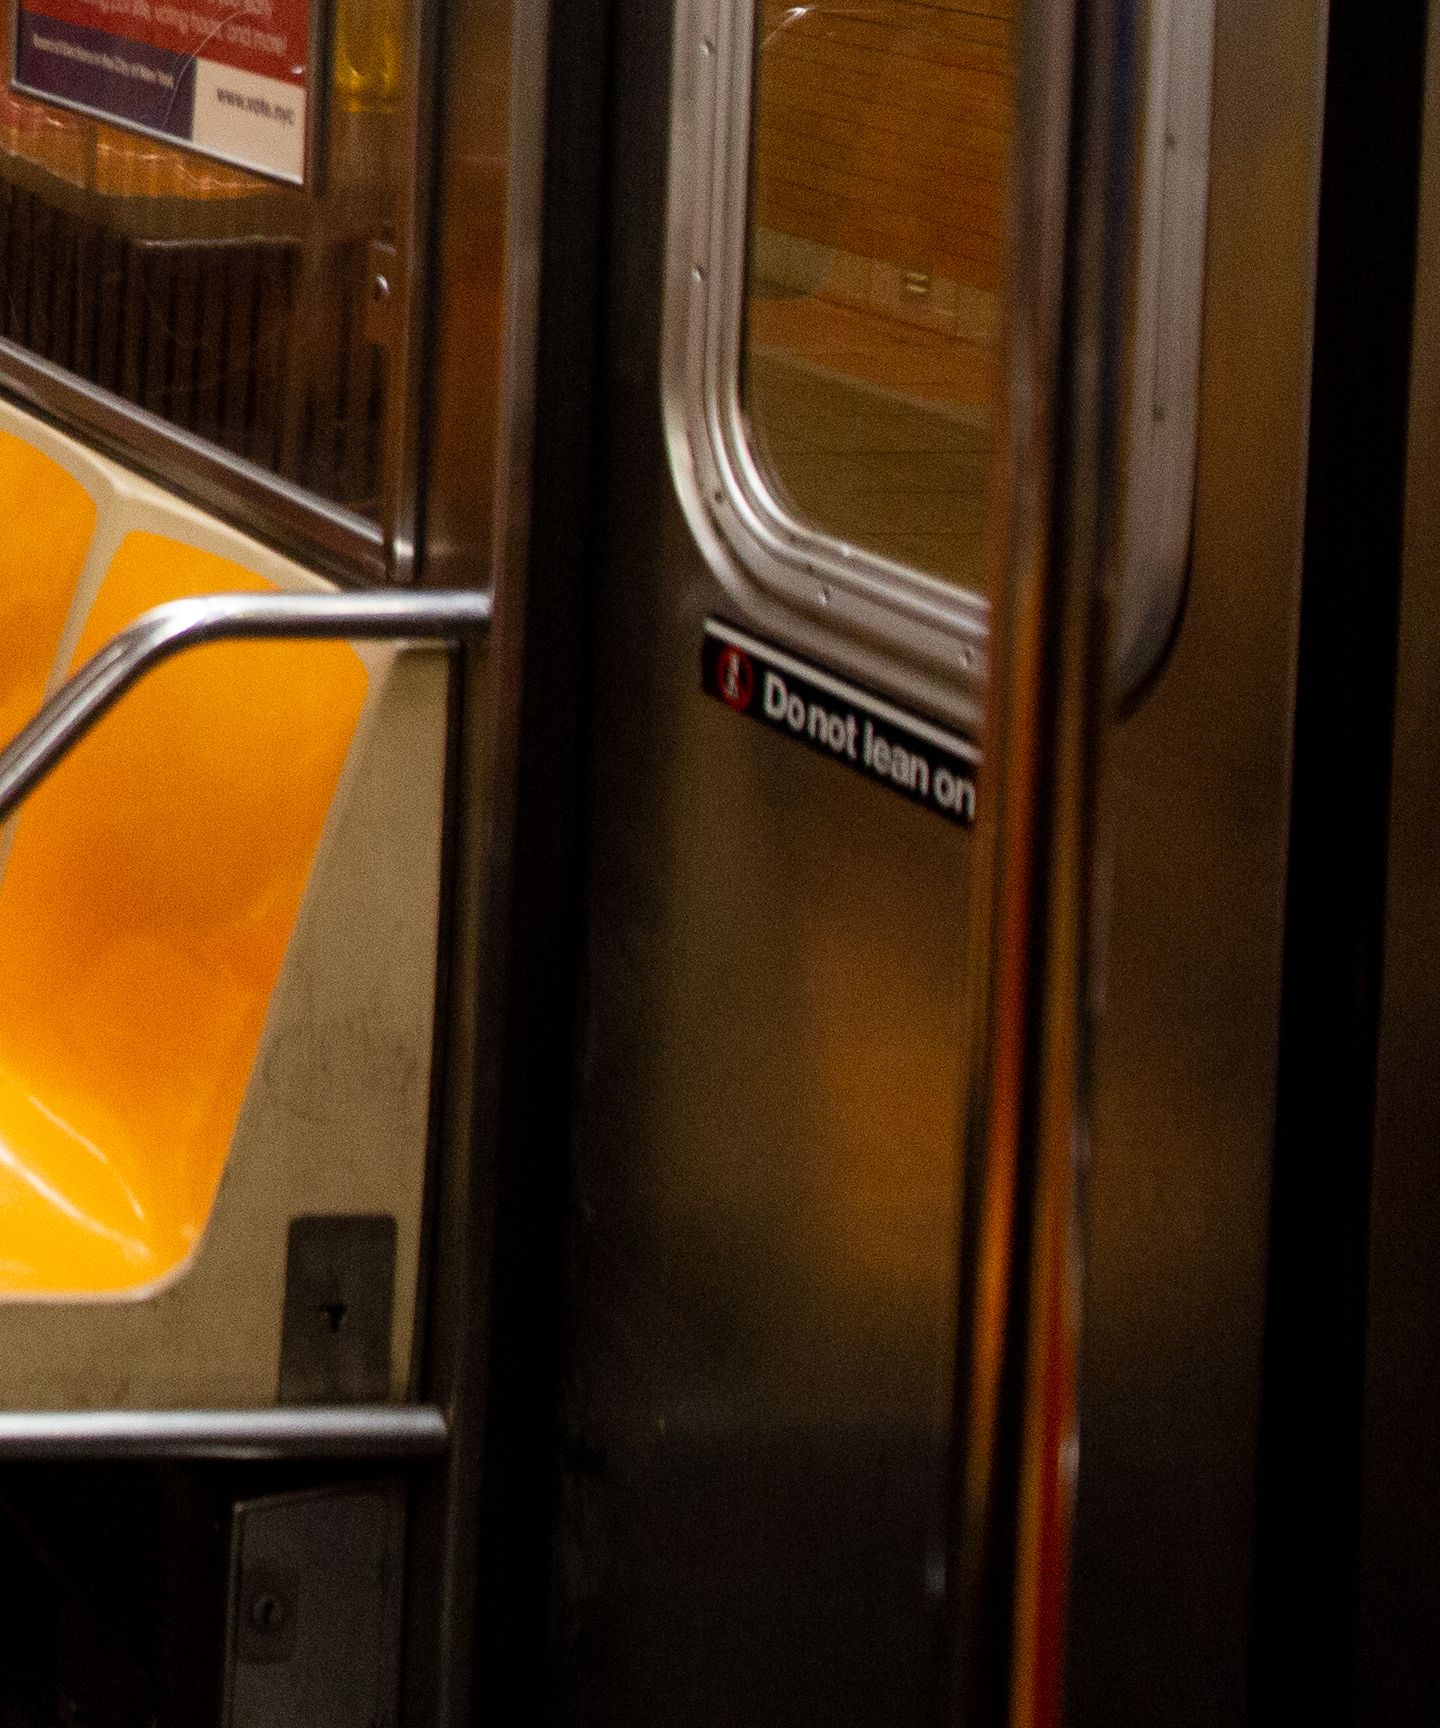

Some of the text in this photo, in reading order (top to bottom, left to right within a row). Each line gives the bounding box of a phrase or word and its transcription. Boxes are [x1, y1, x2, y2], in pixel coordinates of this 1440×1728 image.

[217, 87, 294, 126] www.vote.nyc
[763, 672, 976, 821] Do not lean on
